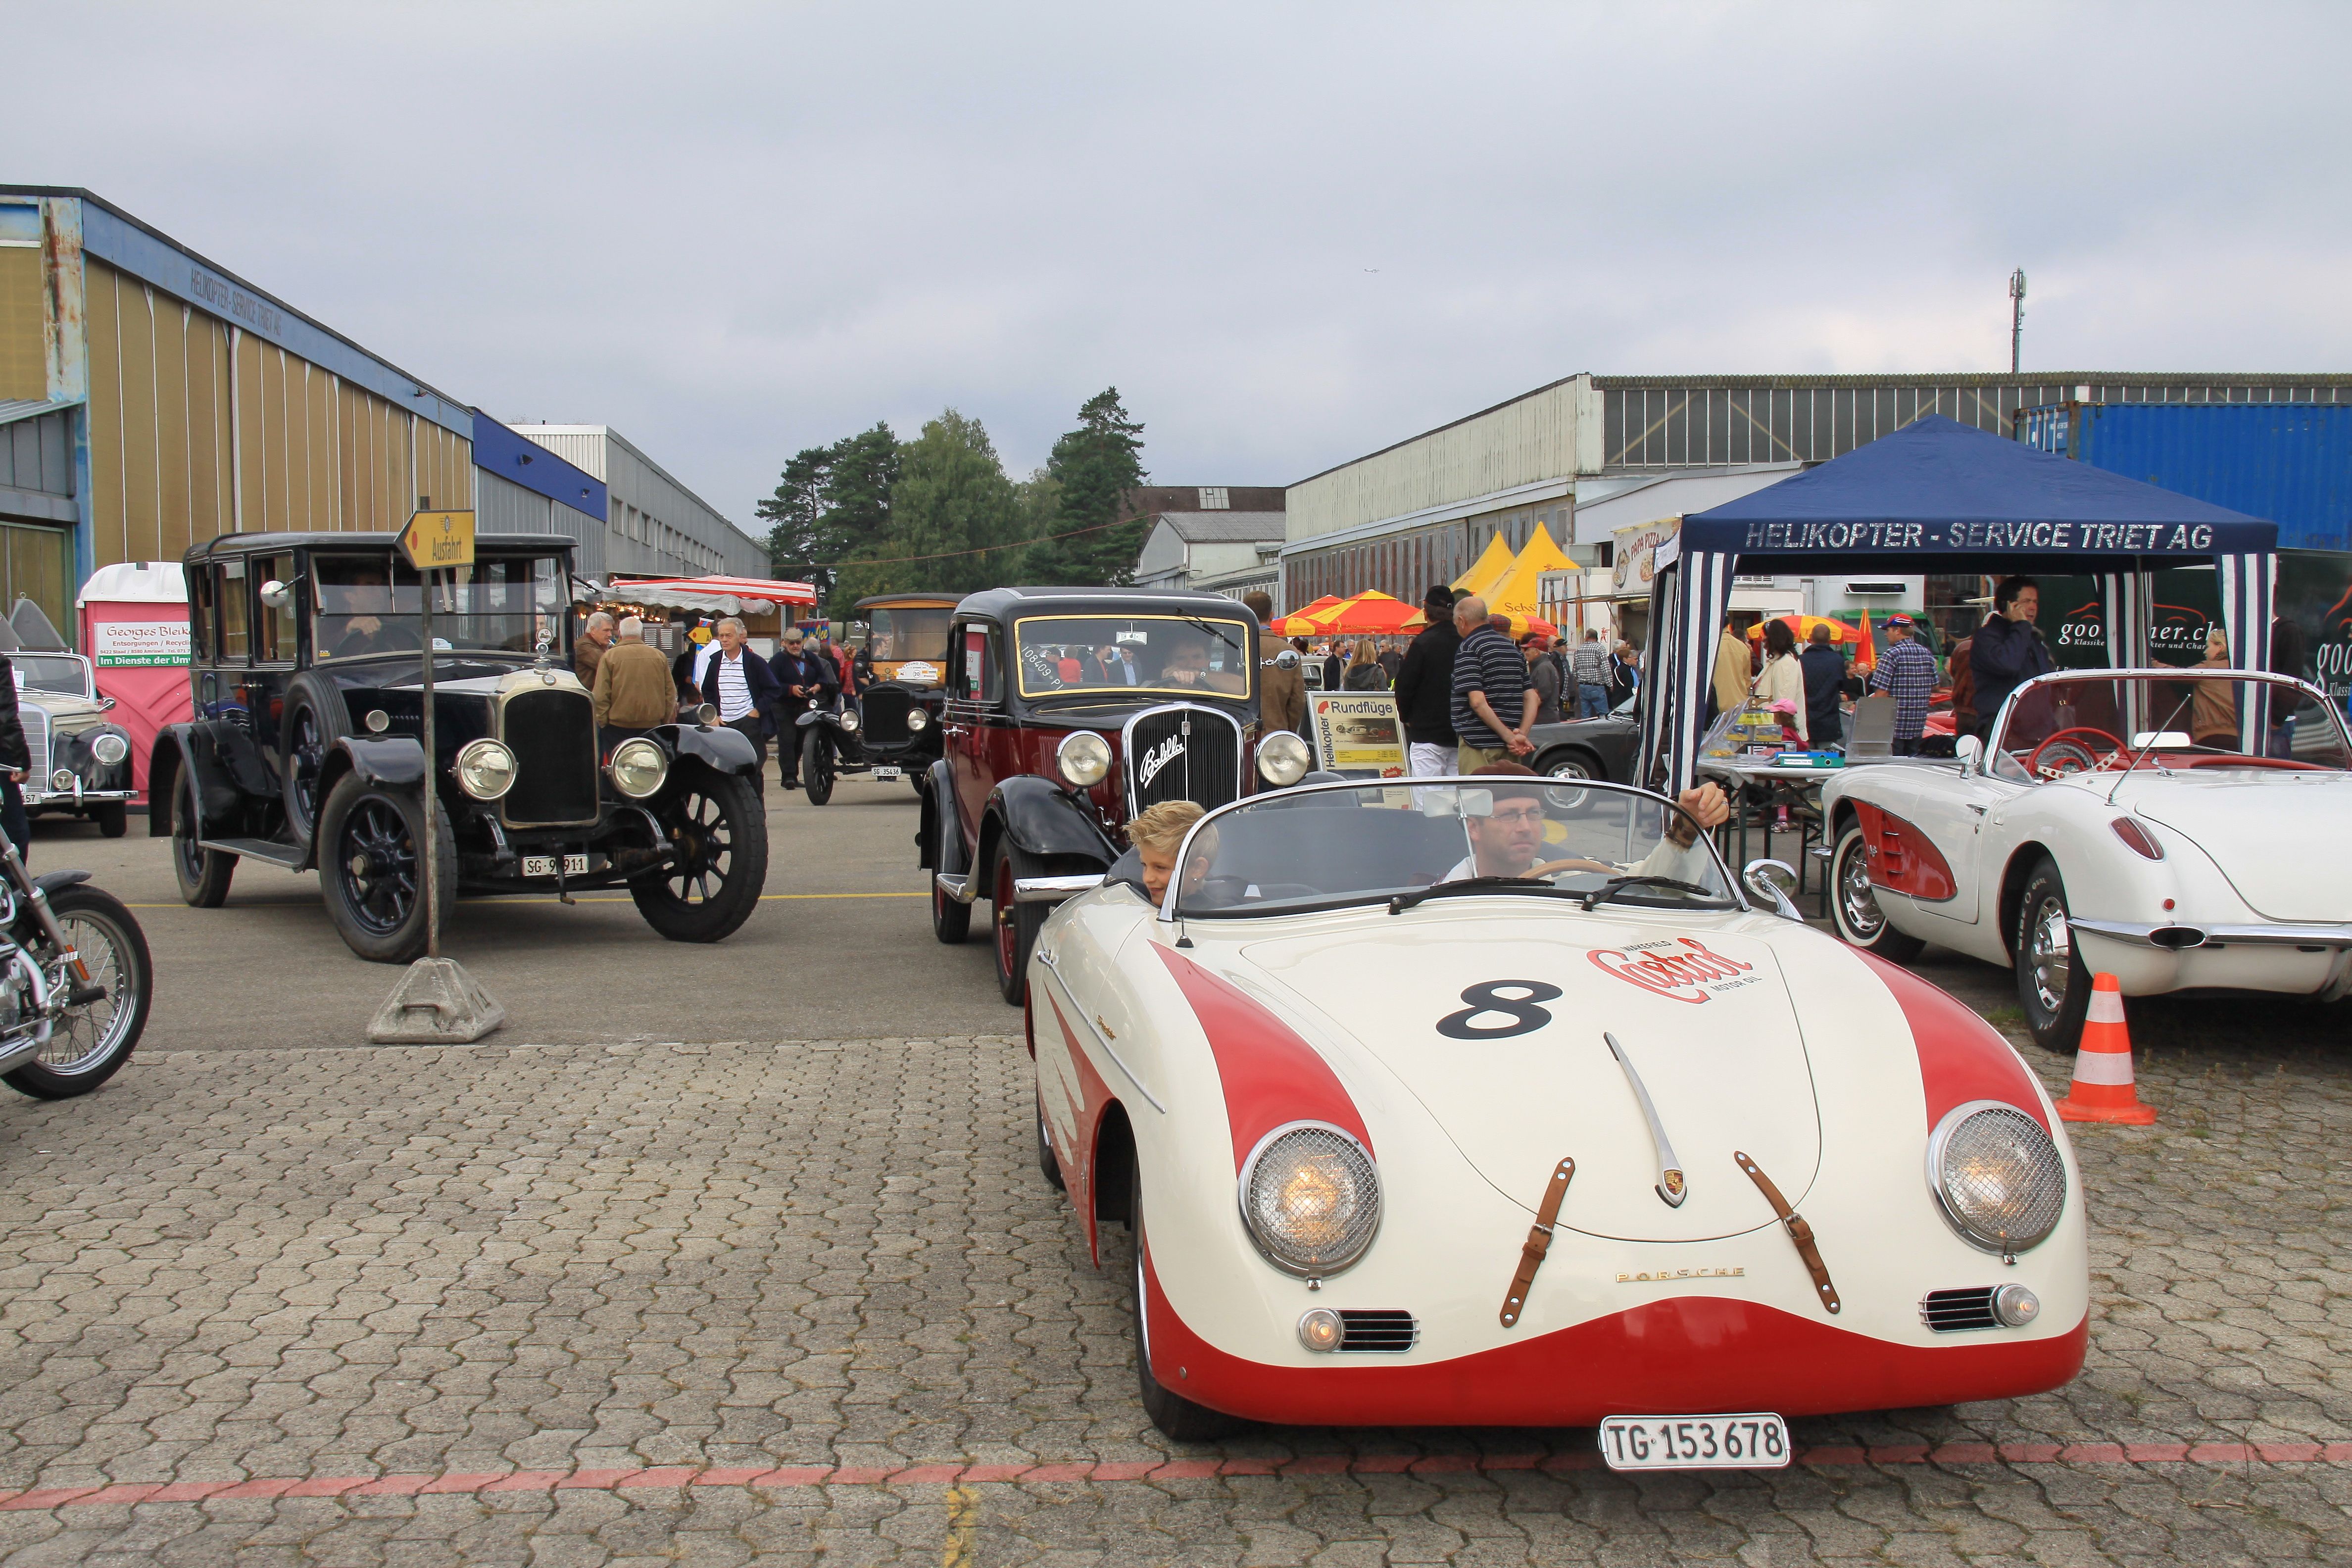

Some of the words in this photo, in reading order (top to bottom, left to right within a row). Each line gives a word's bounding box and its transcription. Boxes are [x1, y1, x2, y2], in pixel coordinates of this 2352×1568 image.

[191, 268, 228, 311] HELIKOPTER
[232, 291, 256, 324] SERVICE
[258, 303, 273, 332] TRIET
[274, 312, 281, 337] AG
[433, 536, 462, 561] Ausfahrt
[1631, 536, 1644, 561] PAPA
[1645, 532, 1660, 549] PIZZA
[1745, 523, 1923, 548] HELIKOPTER
[1947, 522, 2072, 547] SERVICE
[2080, 524, 2163, 549] TRIET
[2166, 524, 2213, 549] AG
[106, 626, 156, 640] Georges
[158, 626, 191, 637] Bleik
[115, 656, 151, 664] Dienste
[1021, 646, 1051, 676] 108409
[1331, 701, 1393, 716] Rundflüge
[1321, 717, 1335, 768] Helikopter
[1139, 734, 1184, 789] Balilla
[549, 858, 584, 872] 9911
[1620, 940, 1672, 951] WAKEFIELD
[1586, 937, 1754, 1005] Castrol
[1710, 980, 1745, 992] MOTOR
[1436, 980, 1563, 1040] 8
[1616, 1267, 1745, 1282] PORSCHE
